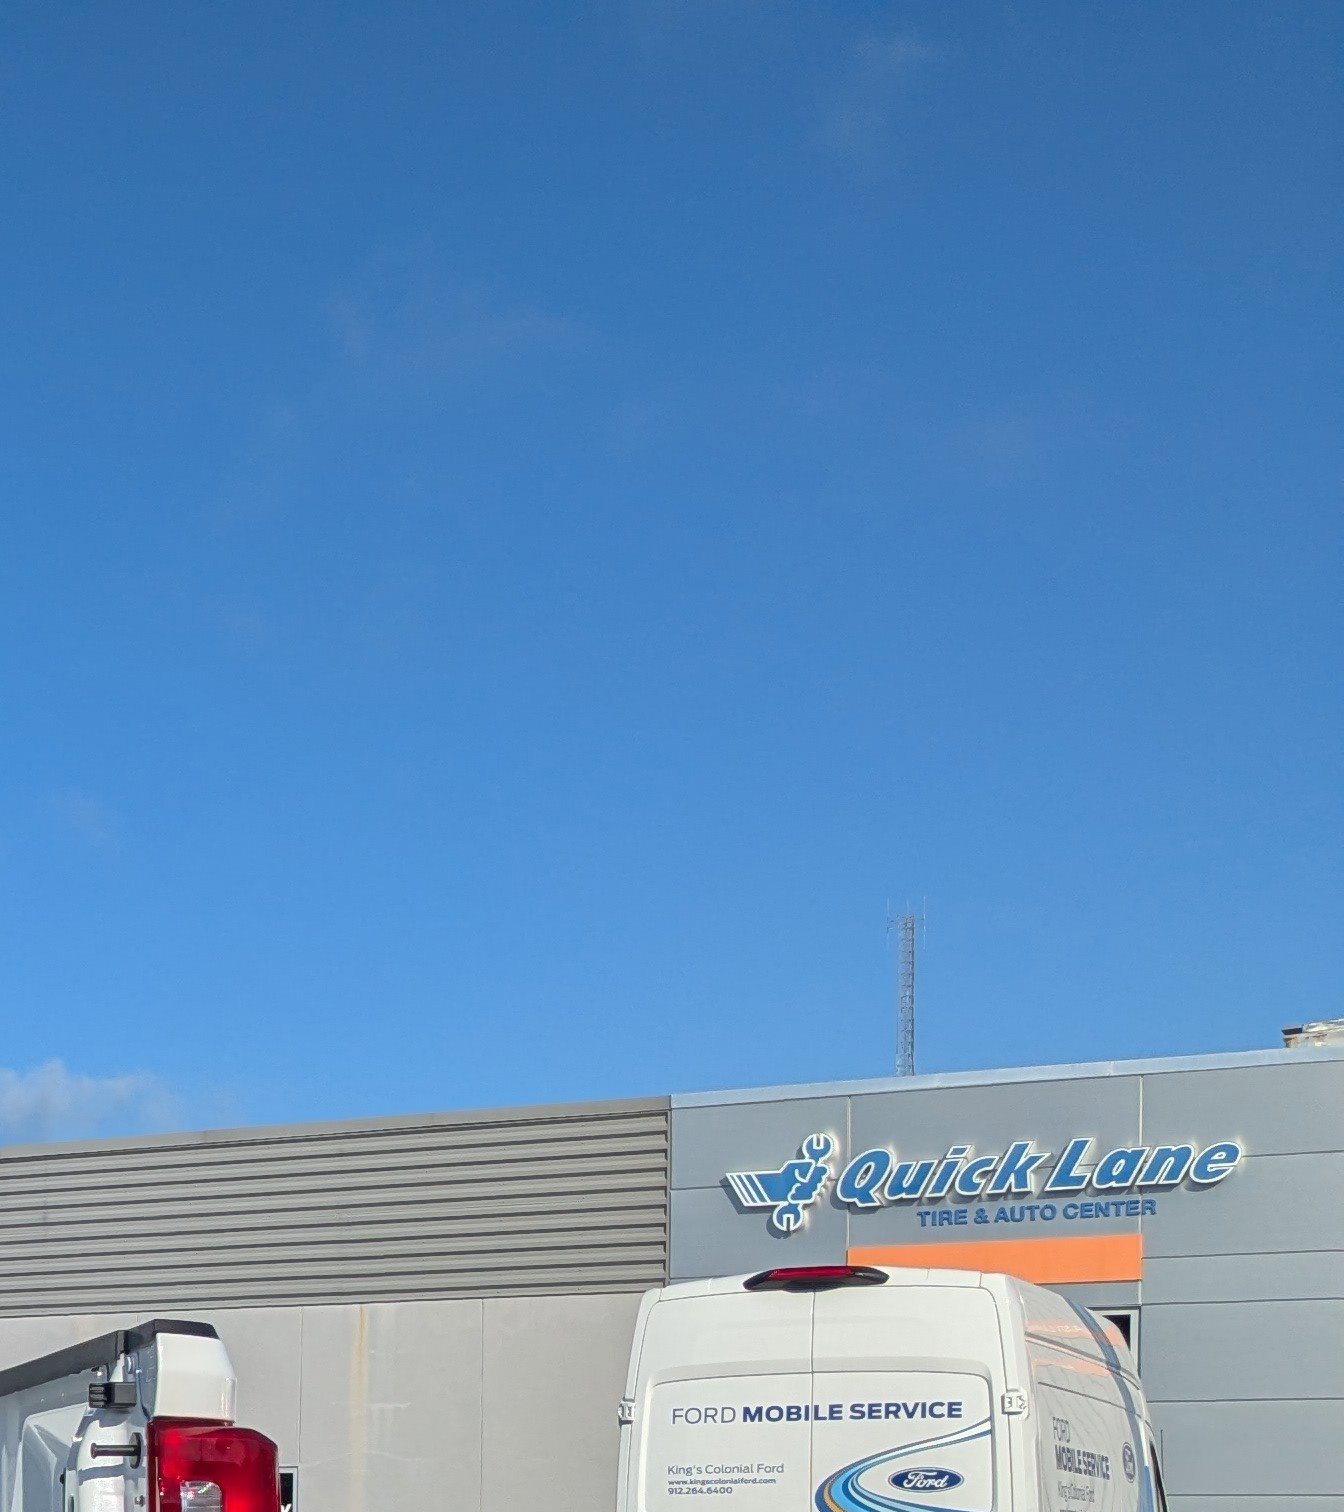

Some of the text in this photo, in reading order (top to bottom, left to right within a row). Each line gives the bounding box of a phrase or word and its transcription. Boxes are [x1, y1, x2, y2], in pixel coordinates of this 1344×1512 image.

[835, 1136, 1243, 1208] Quick Lane
[916, 1199, 1158, 1228] TIRE & AUTO CENTER
[671, 1401, 963, 1425] FORD MOBILE SERVICE
[667, 1463, 785, 1477] King's Colonial Ford
[903, 1471, 950, 1488] Ford
[667, 1486, 733, 1495] 912.264.6400
